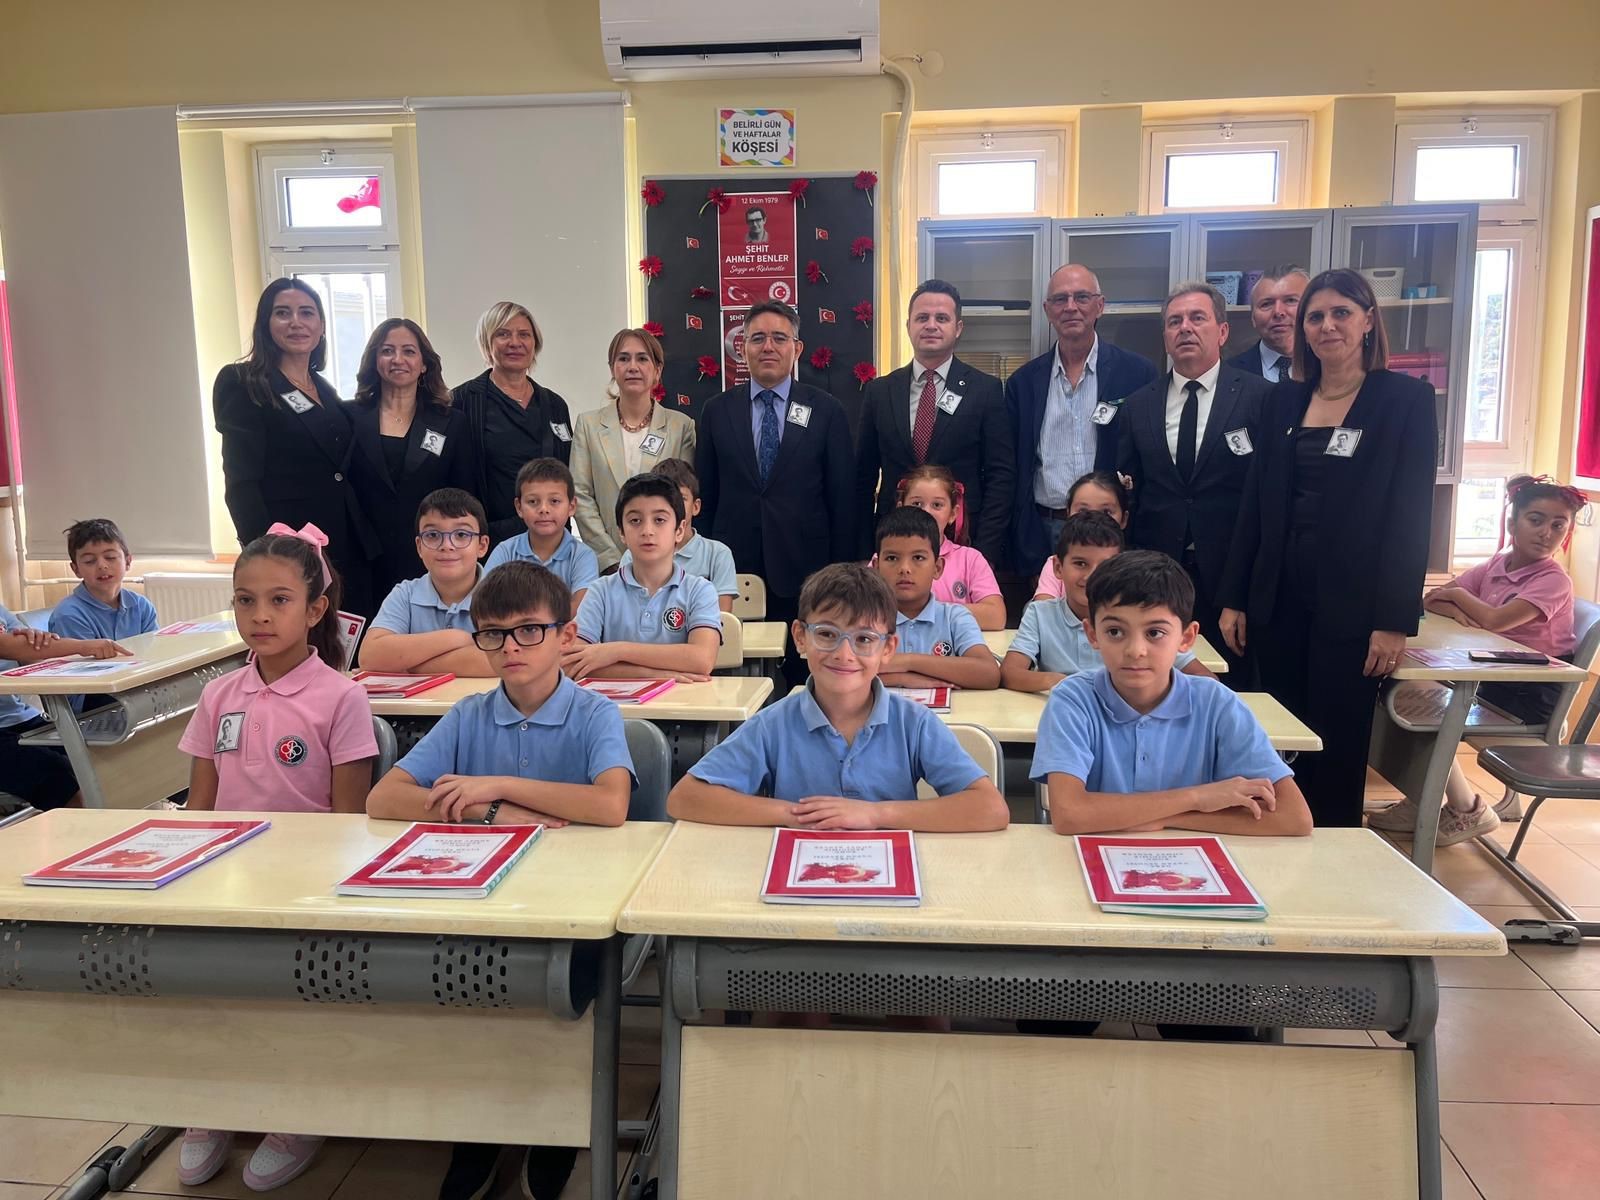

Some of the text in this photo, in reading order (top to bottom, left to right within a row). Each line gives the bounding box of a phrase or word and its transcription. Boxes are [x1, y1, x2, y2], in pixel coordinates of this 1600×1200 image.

[733, 120, 781, 128] BELİRLİ GÜN
[732, 139, 778, 155] KÖŞESİ
[725, 254, 789, 263] AHMET BENLER
